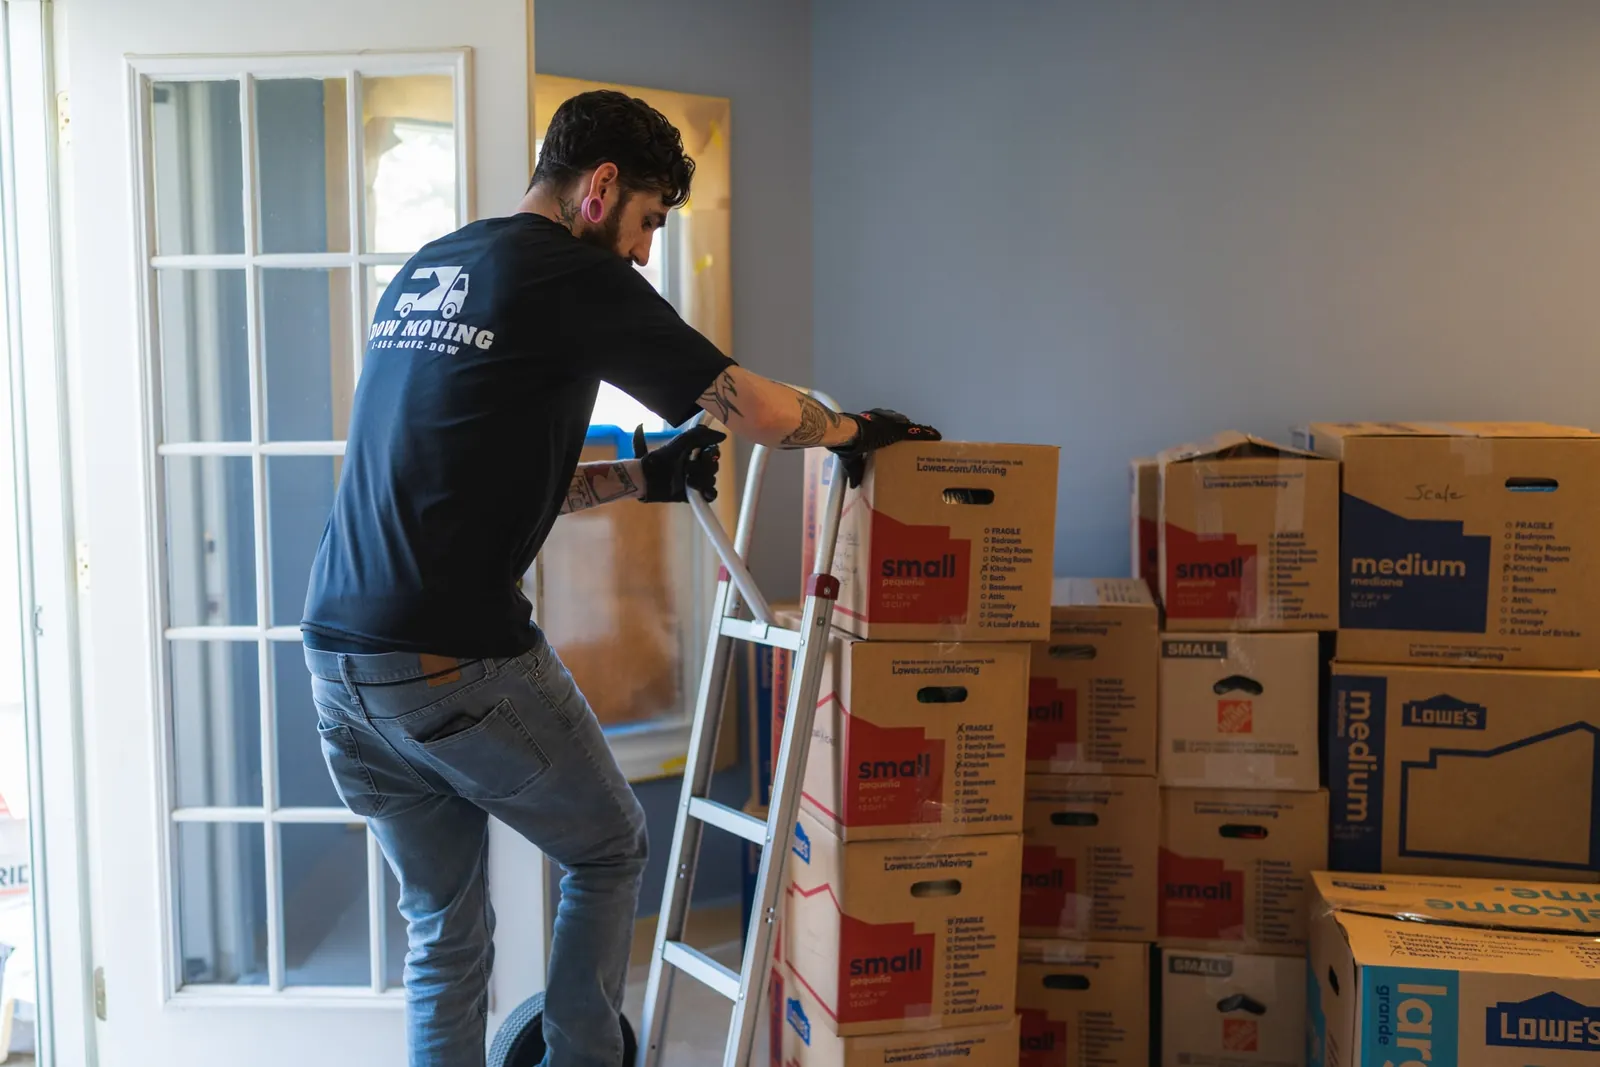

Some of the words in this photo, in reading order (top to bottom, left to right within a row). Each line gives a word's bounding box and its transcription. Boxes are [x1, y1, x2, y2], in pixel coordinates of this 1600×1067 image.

[370, 320, 401, 341] DOW
[401, 319, 495, 350] MOVING
[917, 463, 1007, 477] Lowes.com/Moving
[881, 554, 956, 578] small
[990, 556, 1012, 564] Dining
[1176, 557, 1243, 579] small
[1351, 552, 1466, 577] medium
[1351, 576, 1404, 587] mediana
[1168, 643, 1221, 656] SMALL
[892, 665, 980, 675] Lowes.com/Moving
[1410, 705, 1478, 726] LOWE'S
[857, 753, 931, 779] small
[1346, 690, 1378, 822] medium
[884, 859, 972, 871] Lowes.com/Moving
[1164, 881, 1232, 901] small
[849, 947, 922, 976] small
[1173, 958, 1228, 975] SMALL
[1376, 985, 1394, 1045] grande
